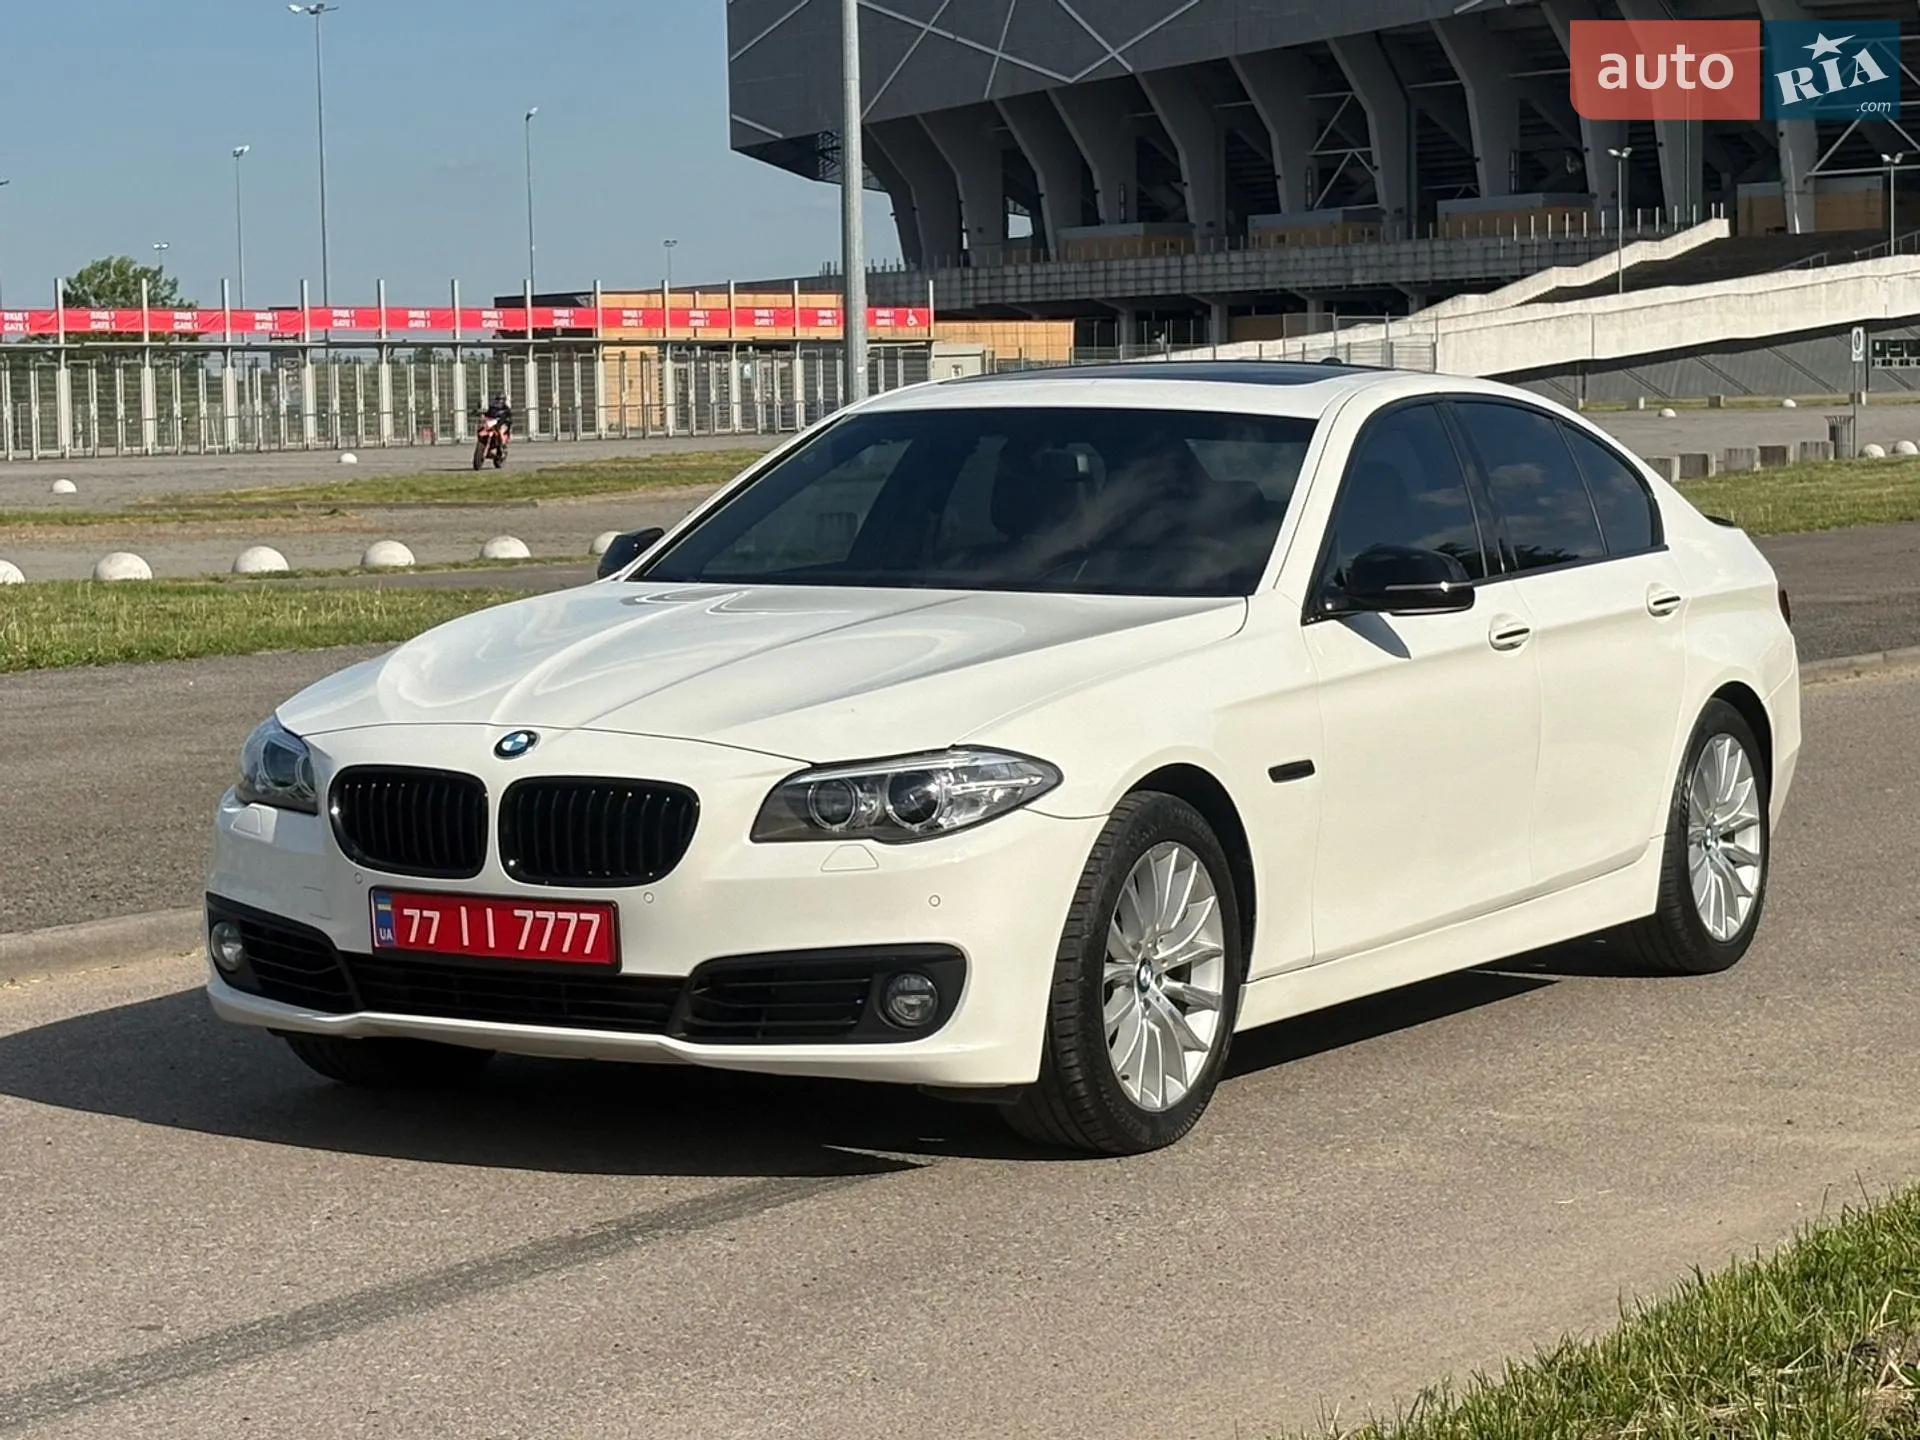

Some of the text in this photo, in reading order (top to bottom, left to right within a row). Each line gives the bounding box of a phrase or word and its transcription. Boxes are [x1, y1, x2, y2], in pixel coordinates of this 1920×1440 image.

[379, 927, 393, 941] UA
[403, 908, 440, 945] 77
[513, 909, 600, 955] 7777
